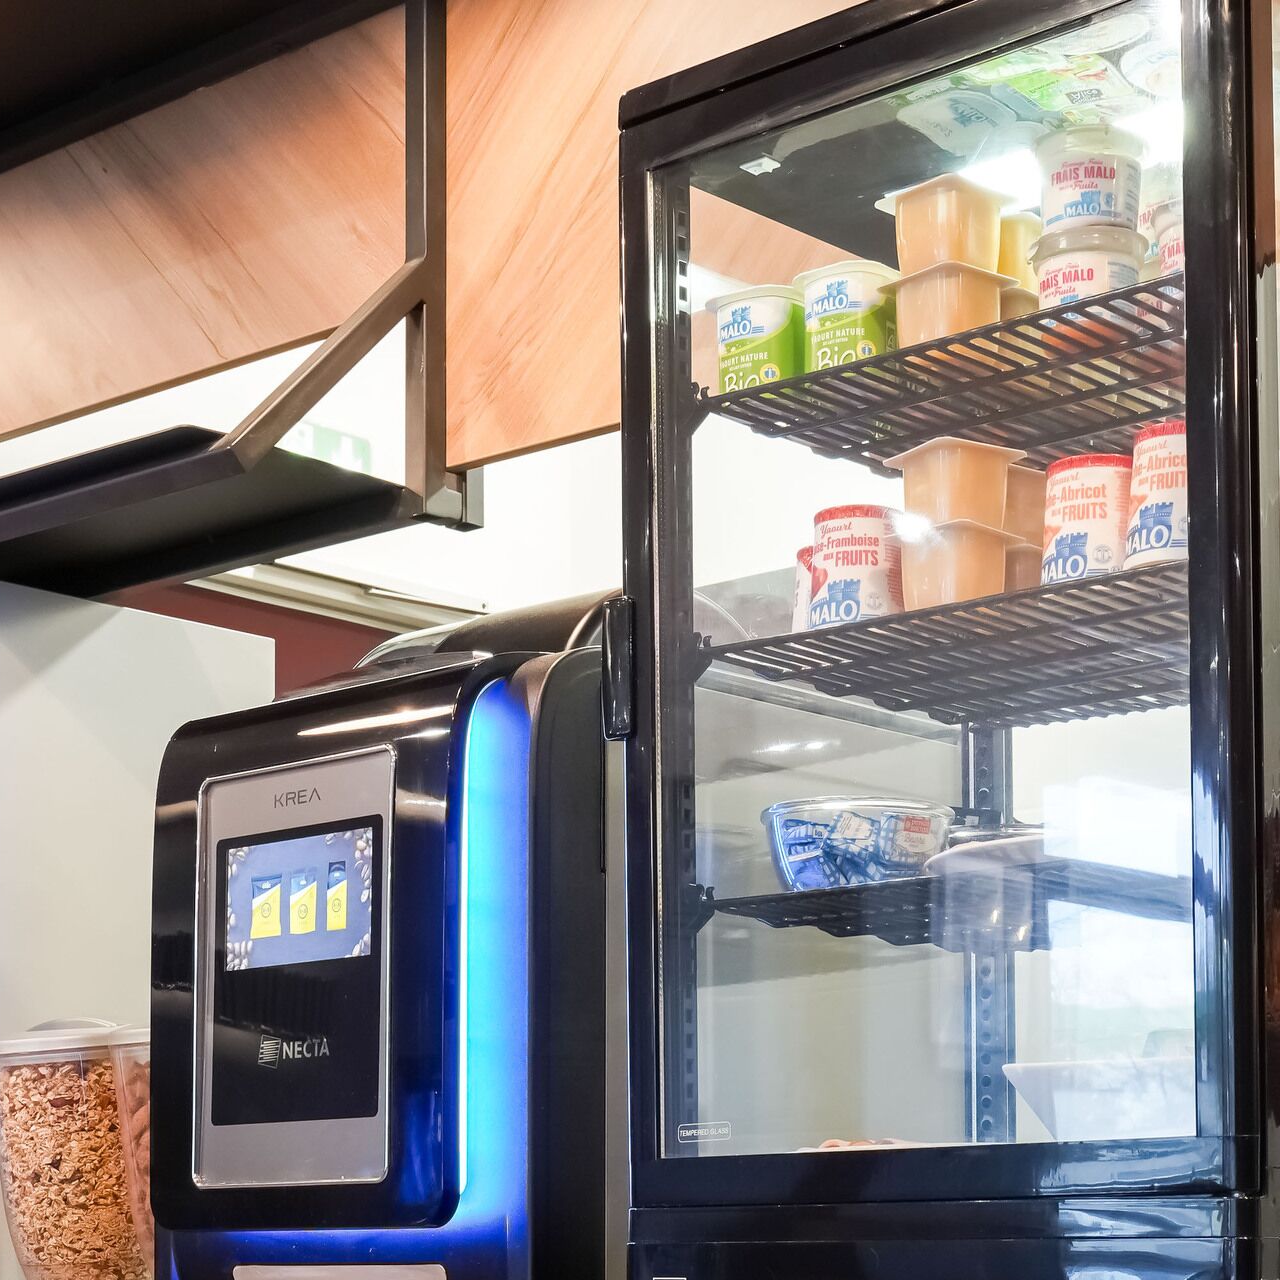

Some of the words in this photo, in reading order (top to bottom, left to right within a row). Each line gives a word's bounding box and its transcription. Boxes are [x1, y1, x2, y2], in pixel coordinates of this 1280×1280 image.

[1051, 167, 1080, 187] FRAIS
[1084, 165, 1116, 180] MALO
[1065, 203, 1100, 217] MALO
[1039, 274, 1059, 294] FRAIS
[1062, 267, 1094, 284] MALO
[812, 294, 848, 315] MALO
[720, 320, 751, 339] MALO
[836, 328, 865, 338] NATURE
[740, 352, 769, 362] NATURE
[816, 344, 856, 371] Bio
[724, 372, 760, 393] Bio
[1062, 502, 1108, 522] FRUITS
[820, 522, 852, 538] Yaourt
[835, 549, 879, 568] FRUITS
[1042, 555, 1085, 584] MALO
[810, 600, 858, 627] MALO
[274, 787, 321, 808] KREA
[282, 1038, 330, 1060] NECTA
[680, 1129, 709, 1137] TEMPERED
[710, 1127, 729, 1135] GLASS
